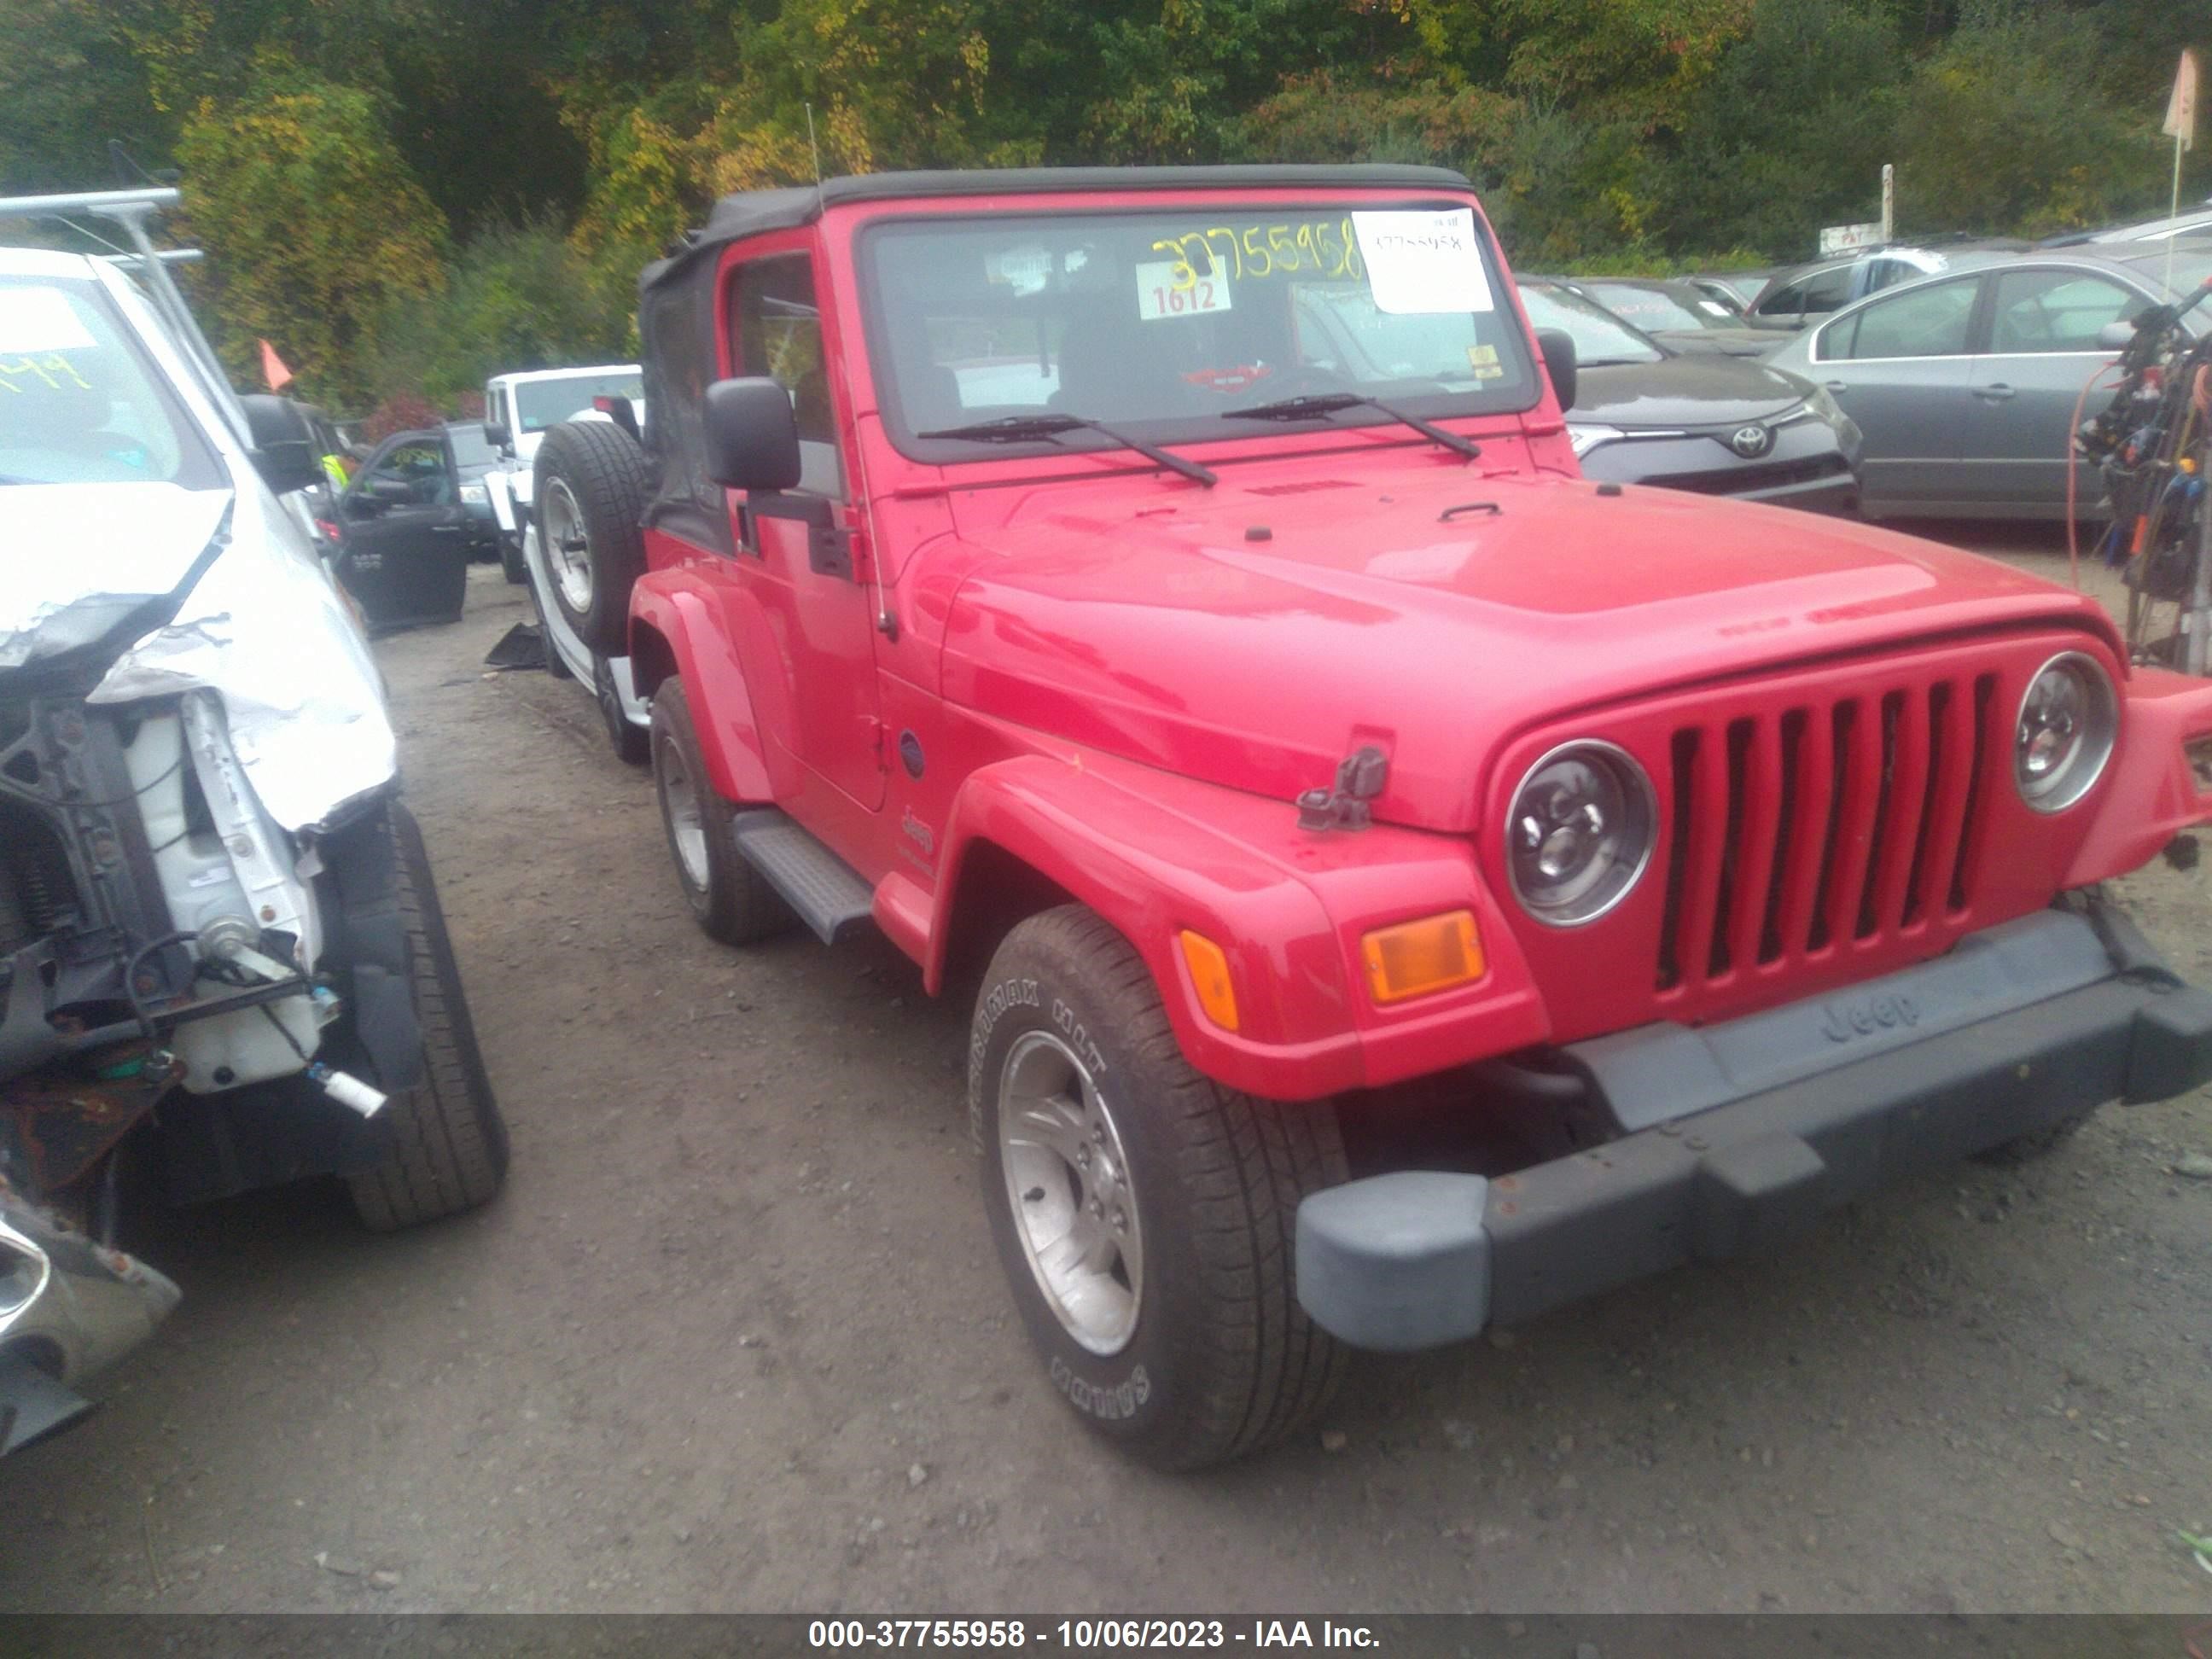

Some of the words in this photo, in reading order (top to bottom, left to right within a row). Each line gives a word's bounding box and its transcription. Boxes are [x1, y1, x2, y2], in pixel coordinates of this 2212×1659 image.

[1153, 218, 1363, 291] 37755958
[1153, 282, 1216, 314] 1612
[1820, 997, 1919, 1043] Jeep
